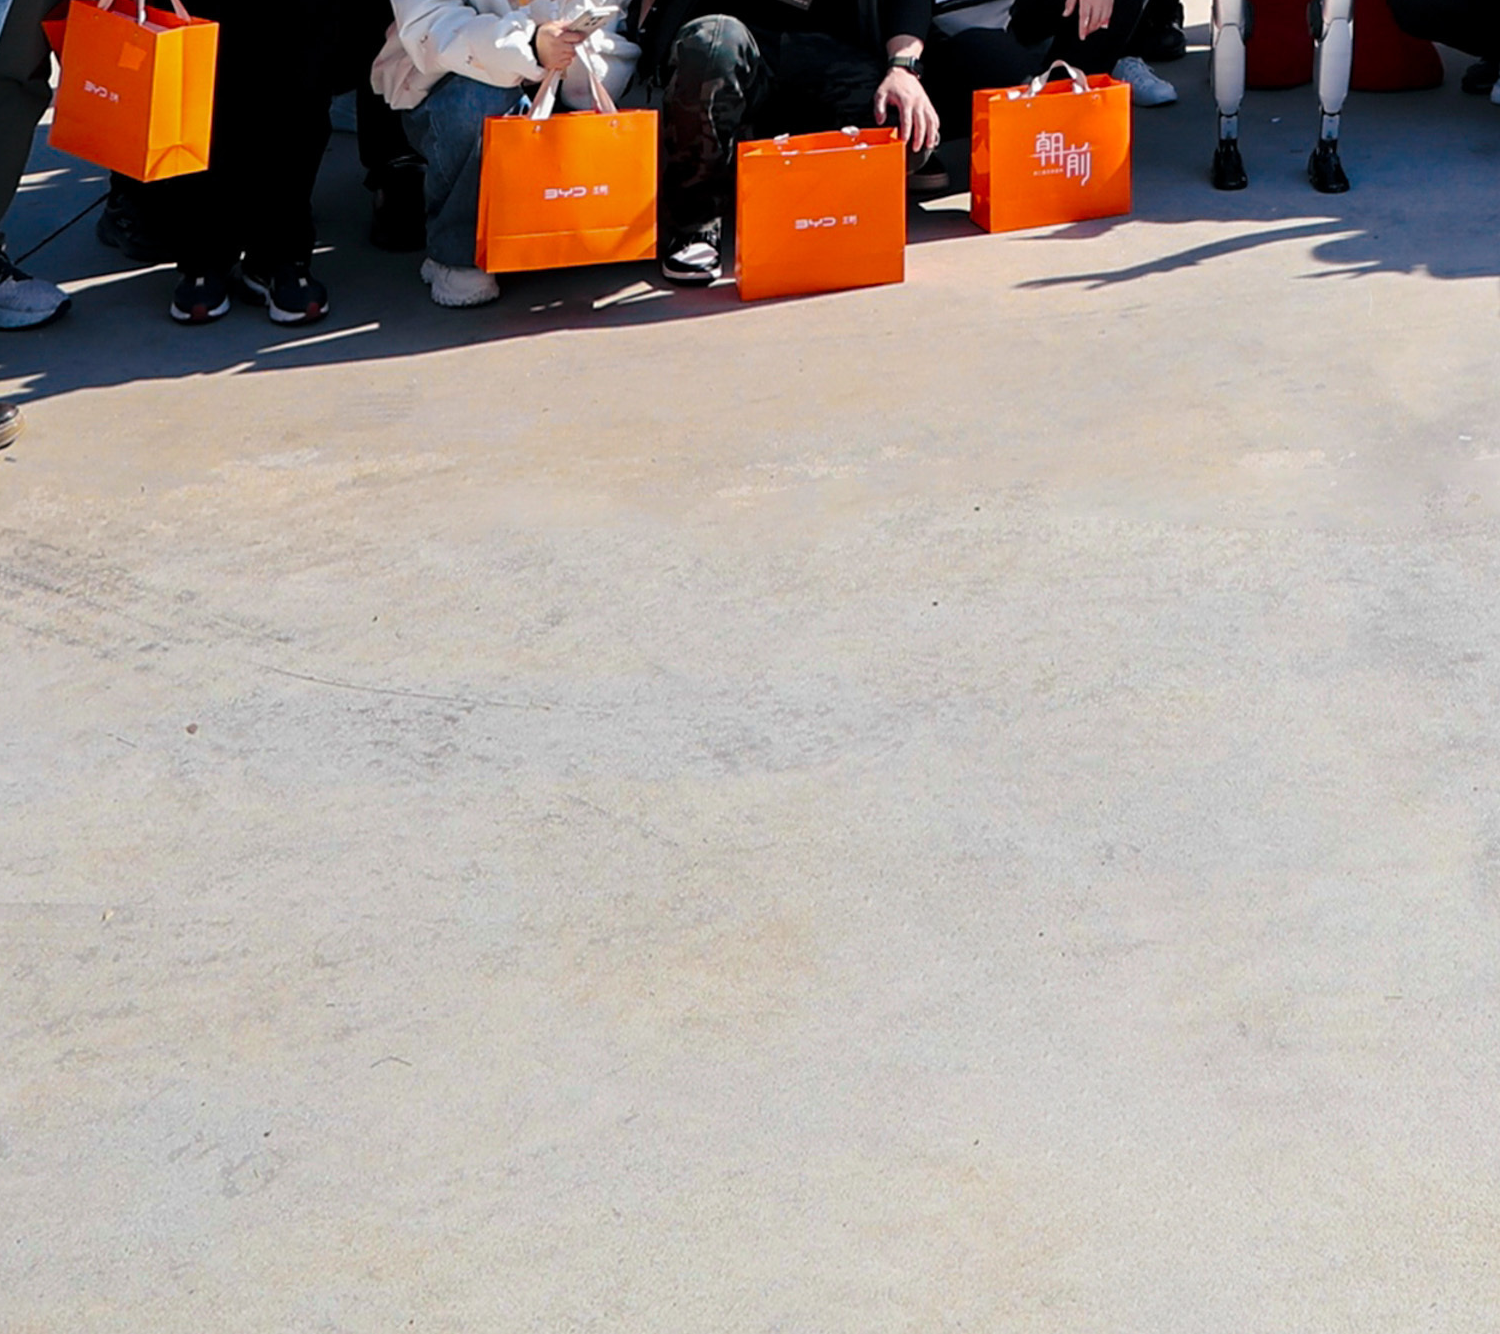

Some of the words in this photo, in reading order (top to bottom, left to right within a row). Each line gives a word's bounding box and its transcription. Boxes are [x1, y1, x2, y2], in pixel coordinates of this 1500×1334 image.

[1031, 131, 1092, 187] 朝前
[544, 186, 587, 200] BYD
[794, 217, 837, 230] BYD
